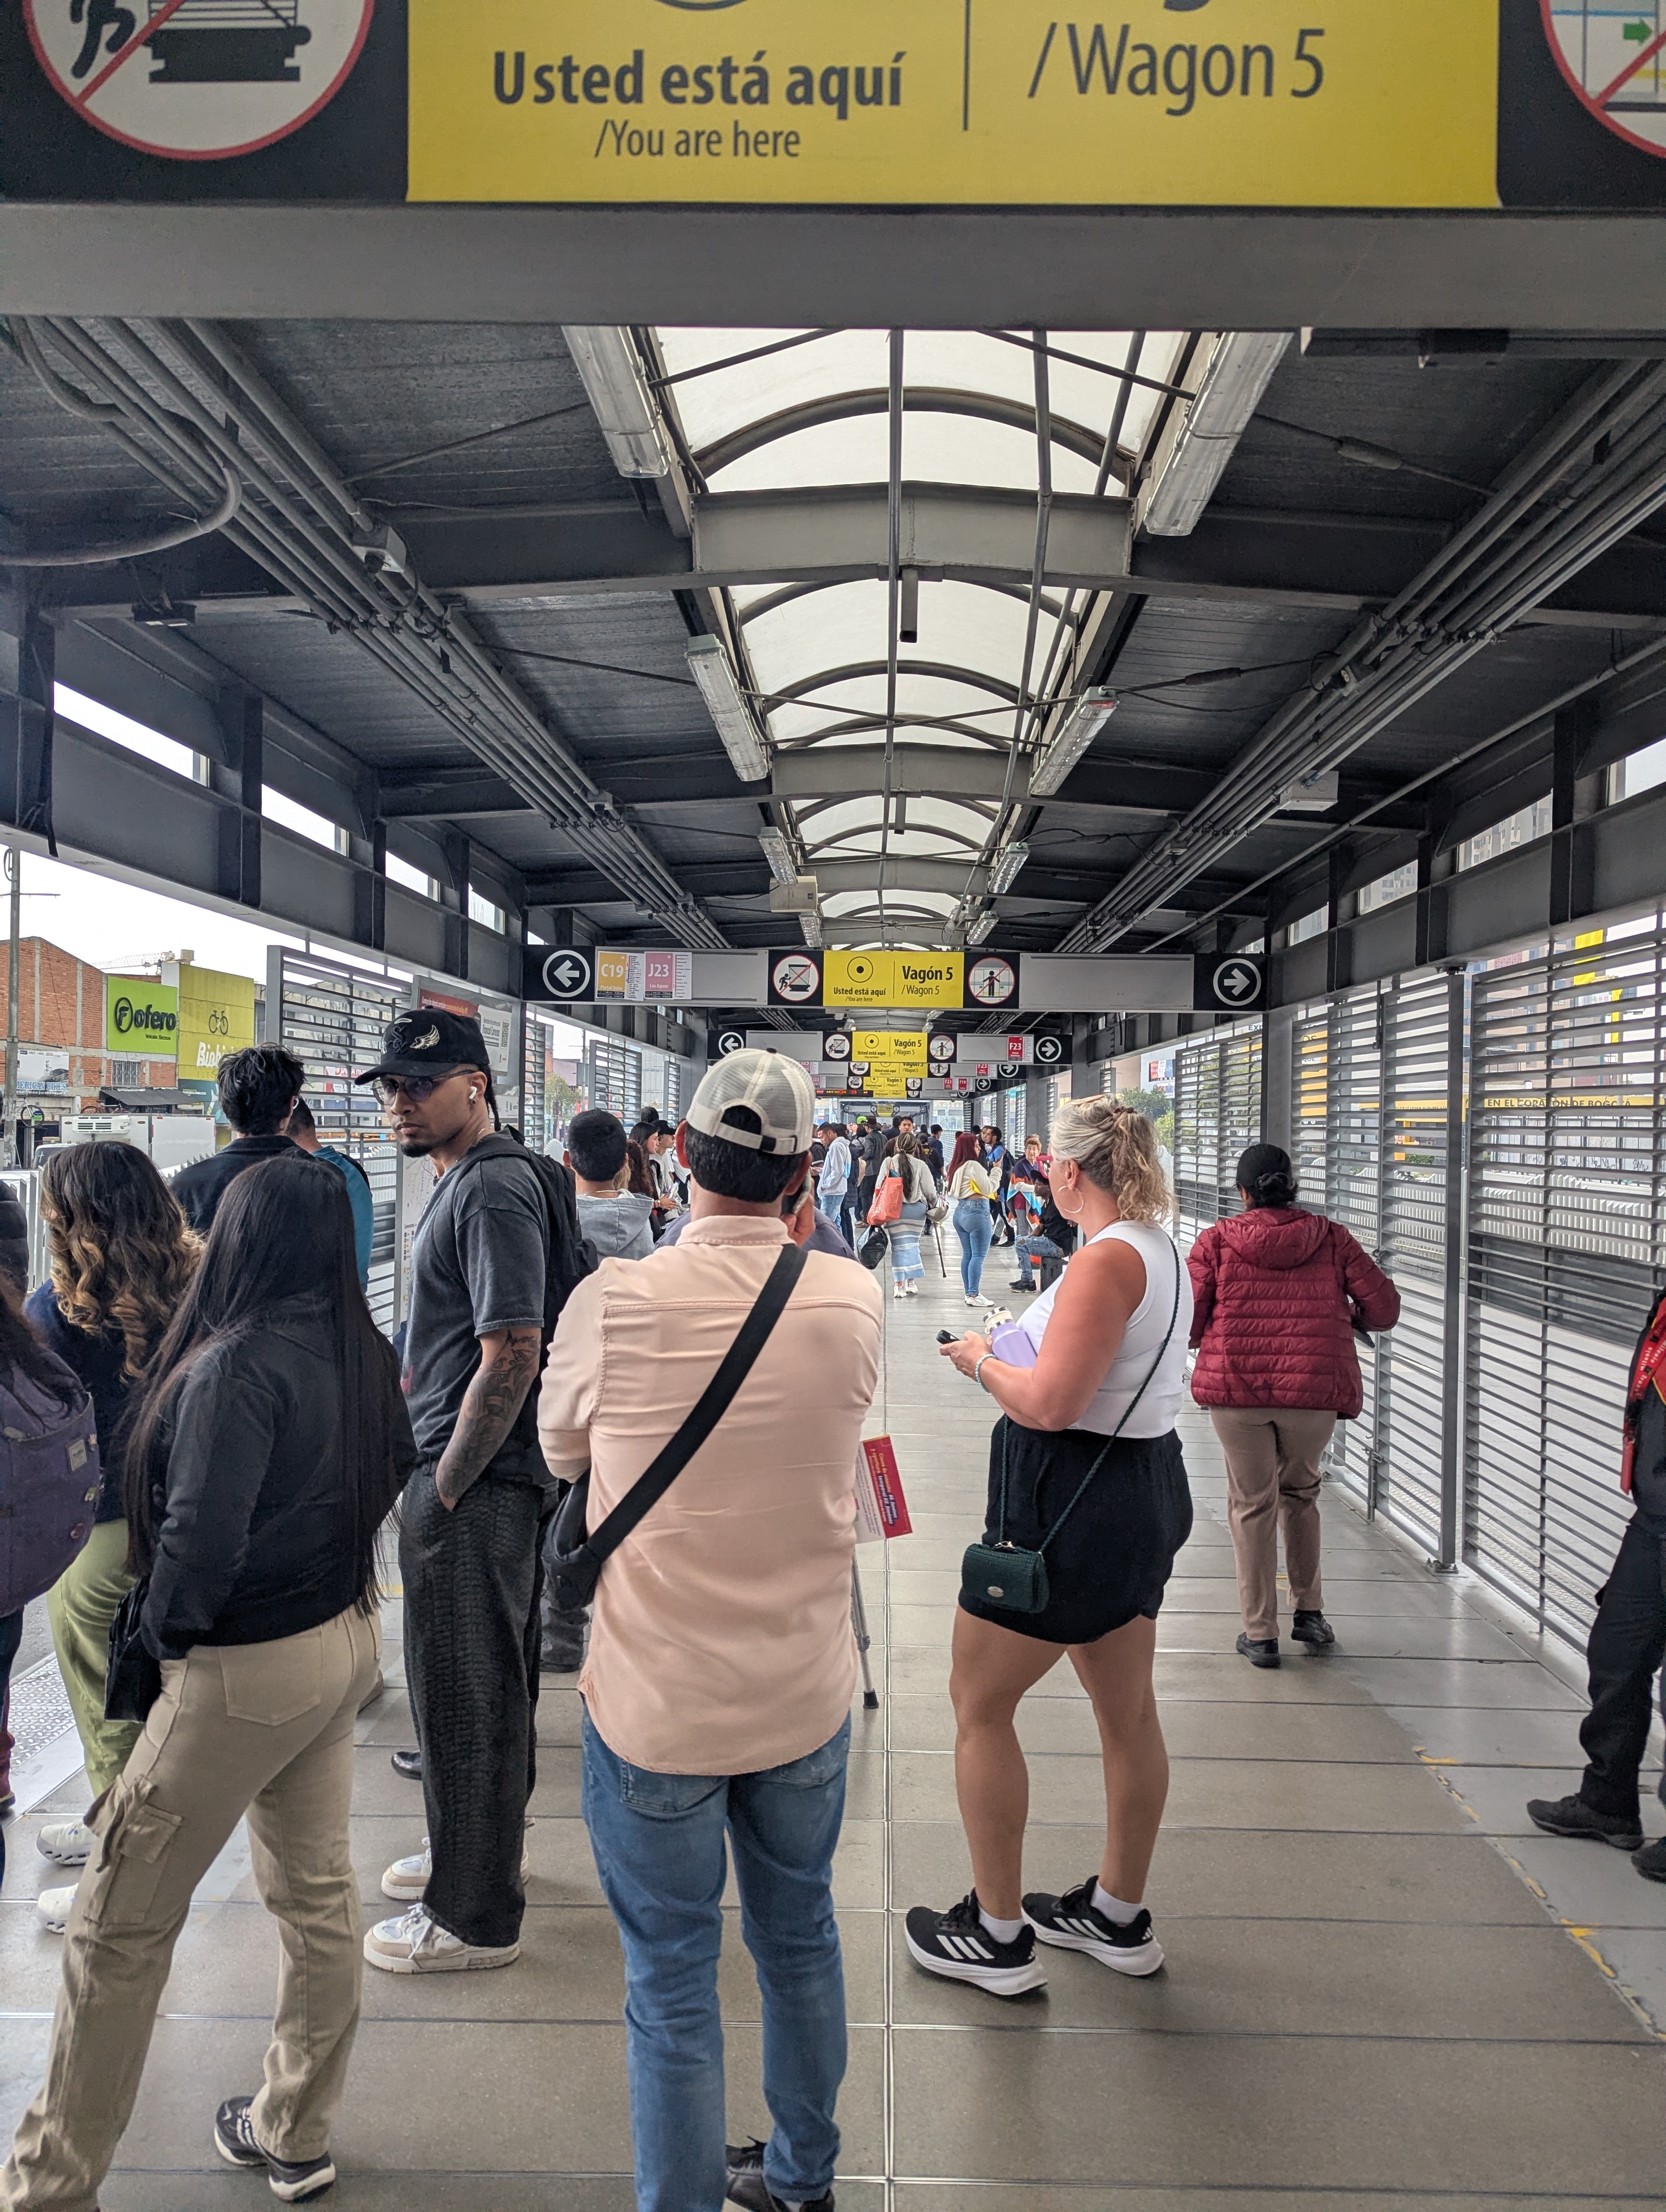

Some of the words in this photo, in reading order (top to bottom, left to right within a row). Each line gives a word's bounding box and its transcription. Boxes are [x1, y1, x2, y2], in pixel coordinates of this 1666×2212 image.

[1027, 22, 1274, 117] /Wagon
[1291, 28, 1325, 98] 5
[494, 50, 644, 106] Usted
[660, 50, 770, 105] está
[786, 52, 906, 120] aquí
[594, 120, 664, 158] /You
[675, 129, 722, 157] are
[733, 120, 800, 158] here
[601, 963, 624, 978] C19
[648, 963, 669, 978] J23
[902, 966, 943, 984] Vagón
[945, 967, 953, 981] 5
[834, 987, 853, 995] Usted
[854, 988, 869, 996] está
[870, 988, 886, 998] aquí
[901, 984, 933, 998] /Wagon
[934, 986, 940, 995] 5
[894, 1039, 916, 1049] Vagón
[918, 1039, 922, 1047] 5
[1009, 1042, 1022, 1050] F23
[47, 1082, 66, 1091] BIKES
